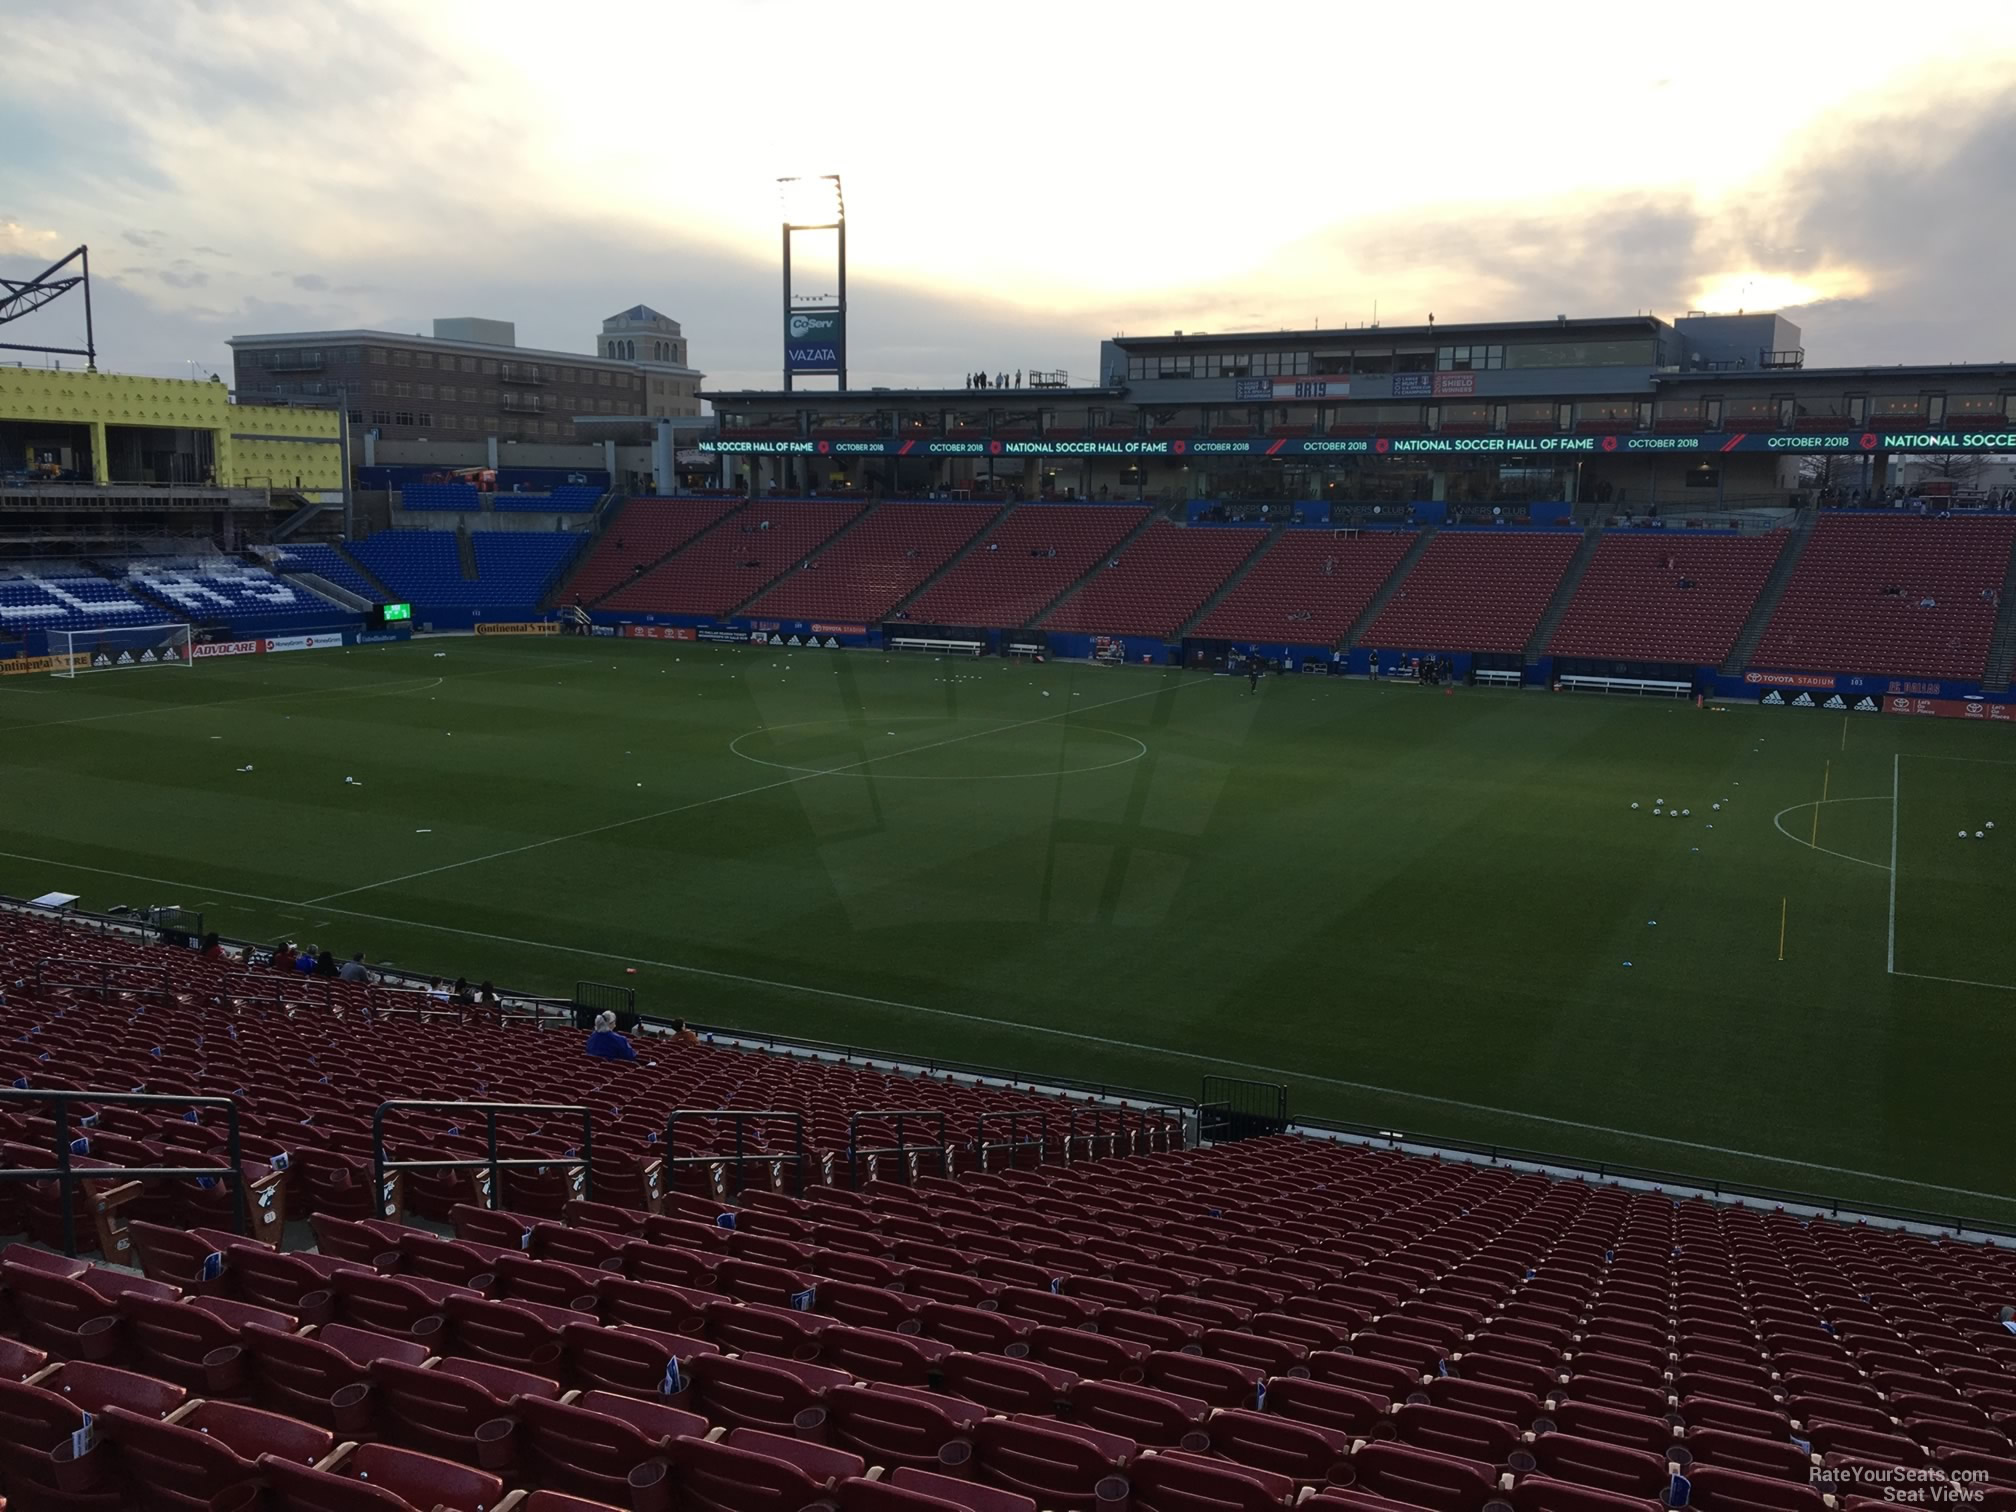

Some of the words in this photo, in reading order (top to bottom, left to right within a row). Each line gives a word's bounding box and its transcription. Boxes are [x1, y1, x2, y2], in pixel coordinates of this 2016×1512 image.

[793, 319, 832, 328] CoServ
[789, 350, 836, 361] VAZATA
[1395, 440, 1453, 451] NATIONAL
[1455, 440, 1505, 450] SOCCER
[1507, 440, 1538, 450] HALL
[1540, 439, 1559, 449] OF
[1561, 439, 1594, 449] FAME
[1629, 439, 1675, 448] OCTOBER
[1677, 438, 1699, 448] 2018
[1768, 437, 1823, 447] OCTOBER
[1825, 437, 1849, 447] 2018
[1885, 435, 1959, 447] NATIONAL
[699, 442, 715, 451] NAL
[717, 442, 751, 451] SOCCER
[753, 442, 774, 451] HALL
[776, 442, 788, 451] OF
[790, 442, 813, 451] FAME
[836, 443, 868, 451] OCTOBER
[870, 443, 884, 451] 2018
[930, 443, 966, 452] OCTOBER
[967, 443, 983, 452] 2018
[1006, 443, 1054, 452] NATIONAL
[1056, 443, 1096, 452] SOCCER
[1098, 443, 1123, 452] HALL
[1125, 443, 1139, 452] OF
[1141, 443, 1167, 452] FAME
[1194, 443, 1231, 451] OCTOBER
[1233, 442, 1249, 451] 2018
[1304, 442, 1346, 450] OCTOBER
[1348, 442, 1367, 450] 2018
[1225, 504, 1261, 512] WINNERS
[1270, 504, 1291, 512] CLUB
[1382, 505, 1404, 513] CLUB
[1451, 506, 1492, 514] WNNERS
[1502, 506, 1526, 515] CLUB
[477, 624, 527, 634] Continental
[194, 641, 256, 656] ADVOCARE
[1763, 675, 1794, 683] TOYOTA
[1798, 677, 1834, 686] STADIUM
[1904, 682, 1940, 695] DALLAS
